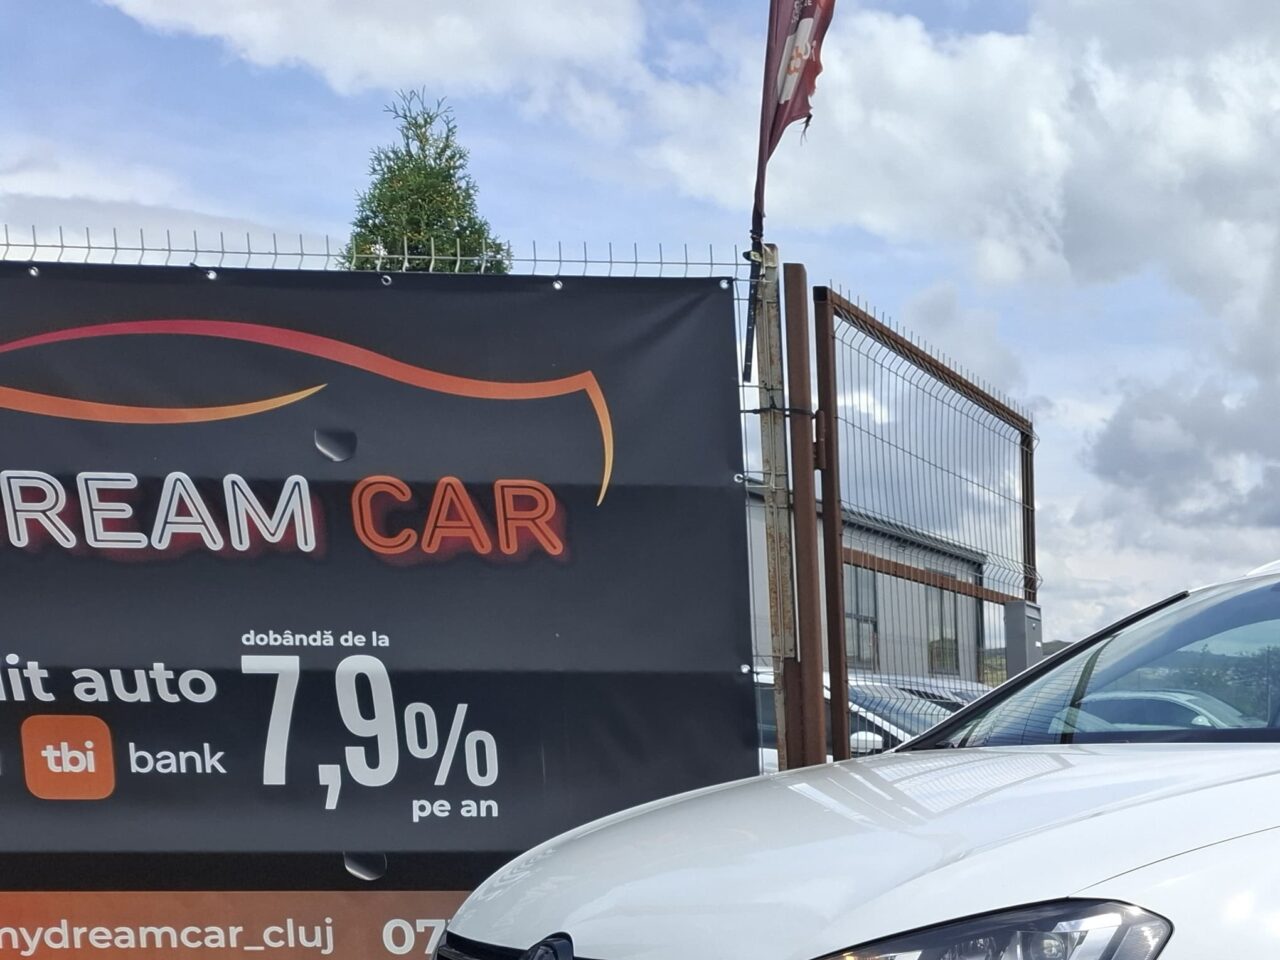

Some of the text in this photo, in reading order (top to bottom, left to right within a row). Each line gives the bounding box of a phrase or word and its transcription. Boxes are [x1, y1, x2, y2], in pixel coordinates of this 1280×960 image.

[351, 474, 564, 555] CAR
[241, 630, 390, 647] dobândă de la
[0, 652, 218, 703] it auto
[41, 740, 228, 774] tbi bank
[412, 799, 499, 823] pe an
[382, 918, 453, 955] 07
